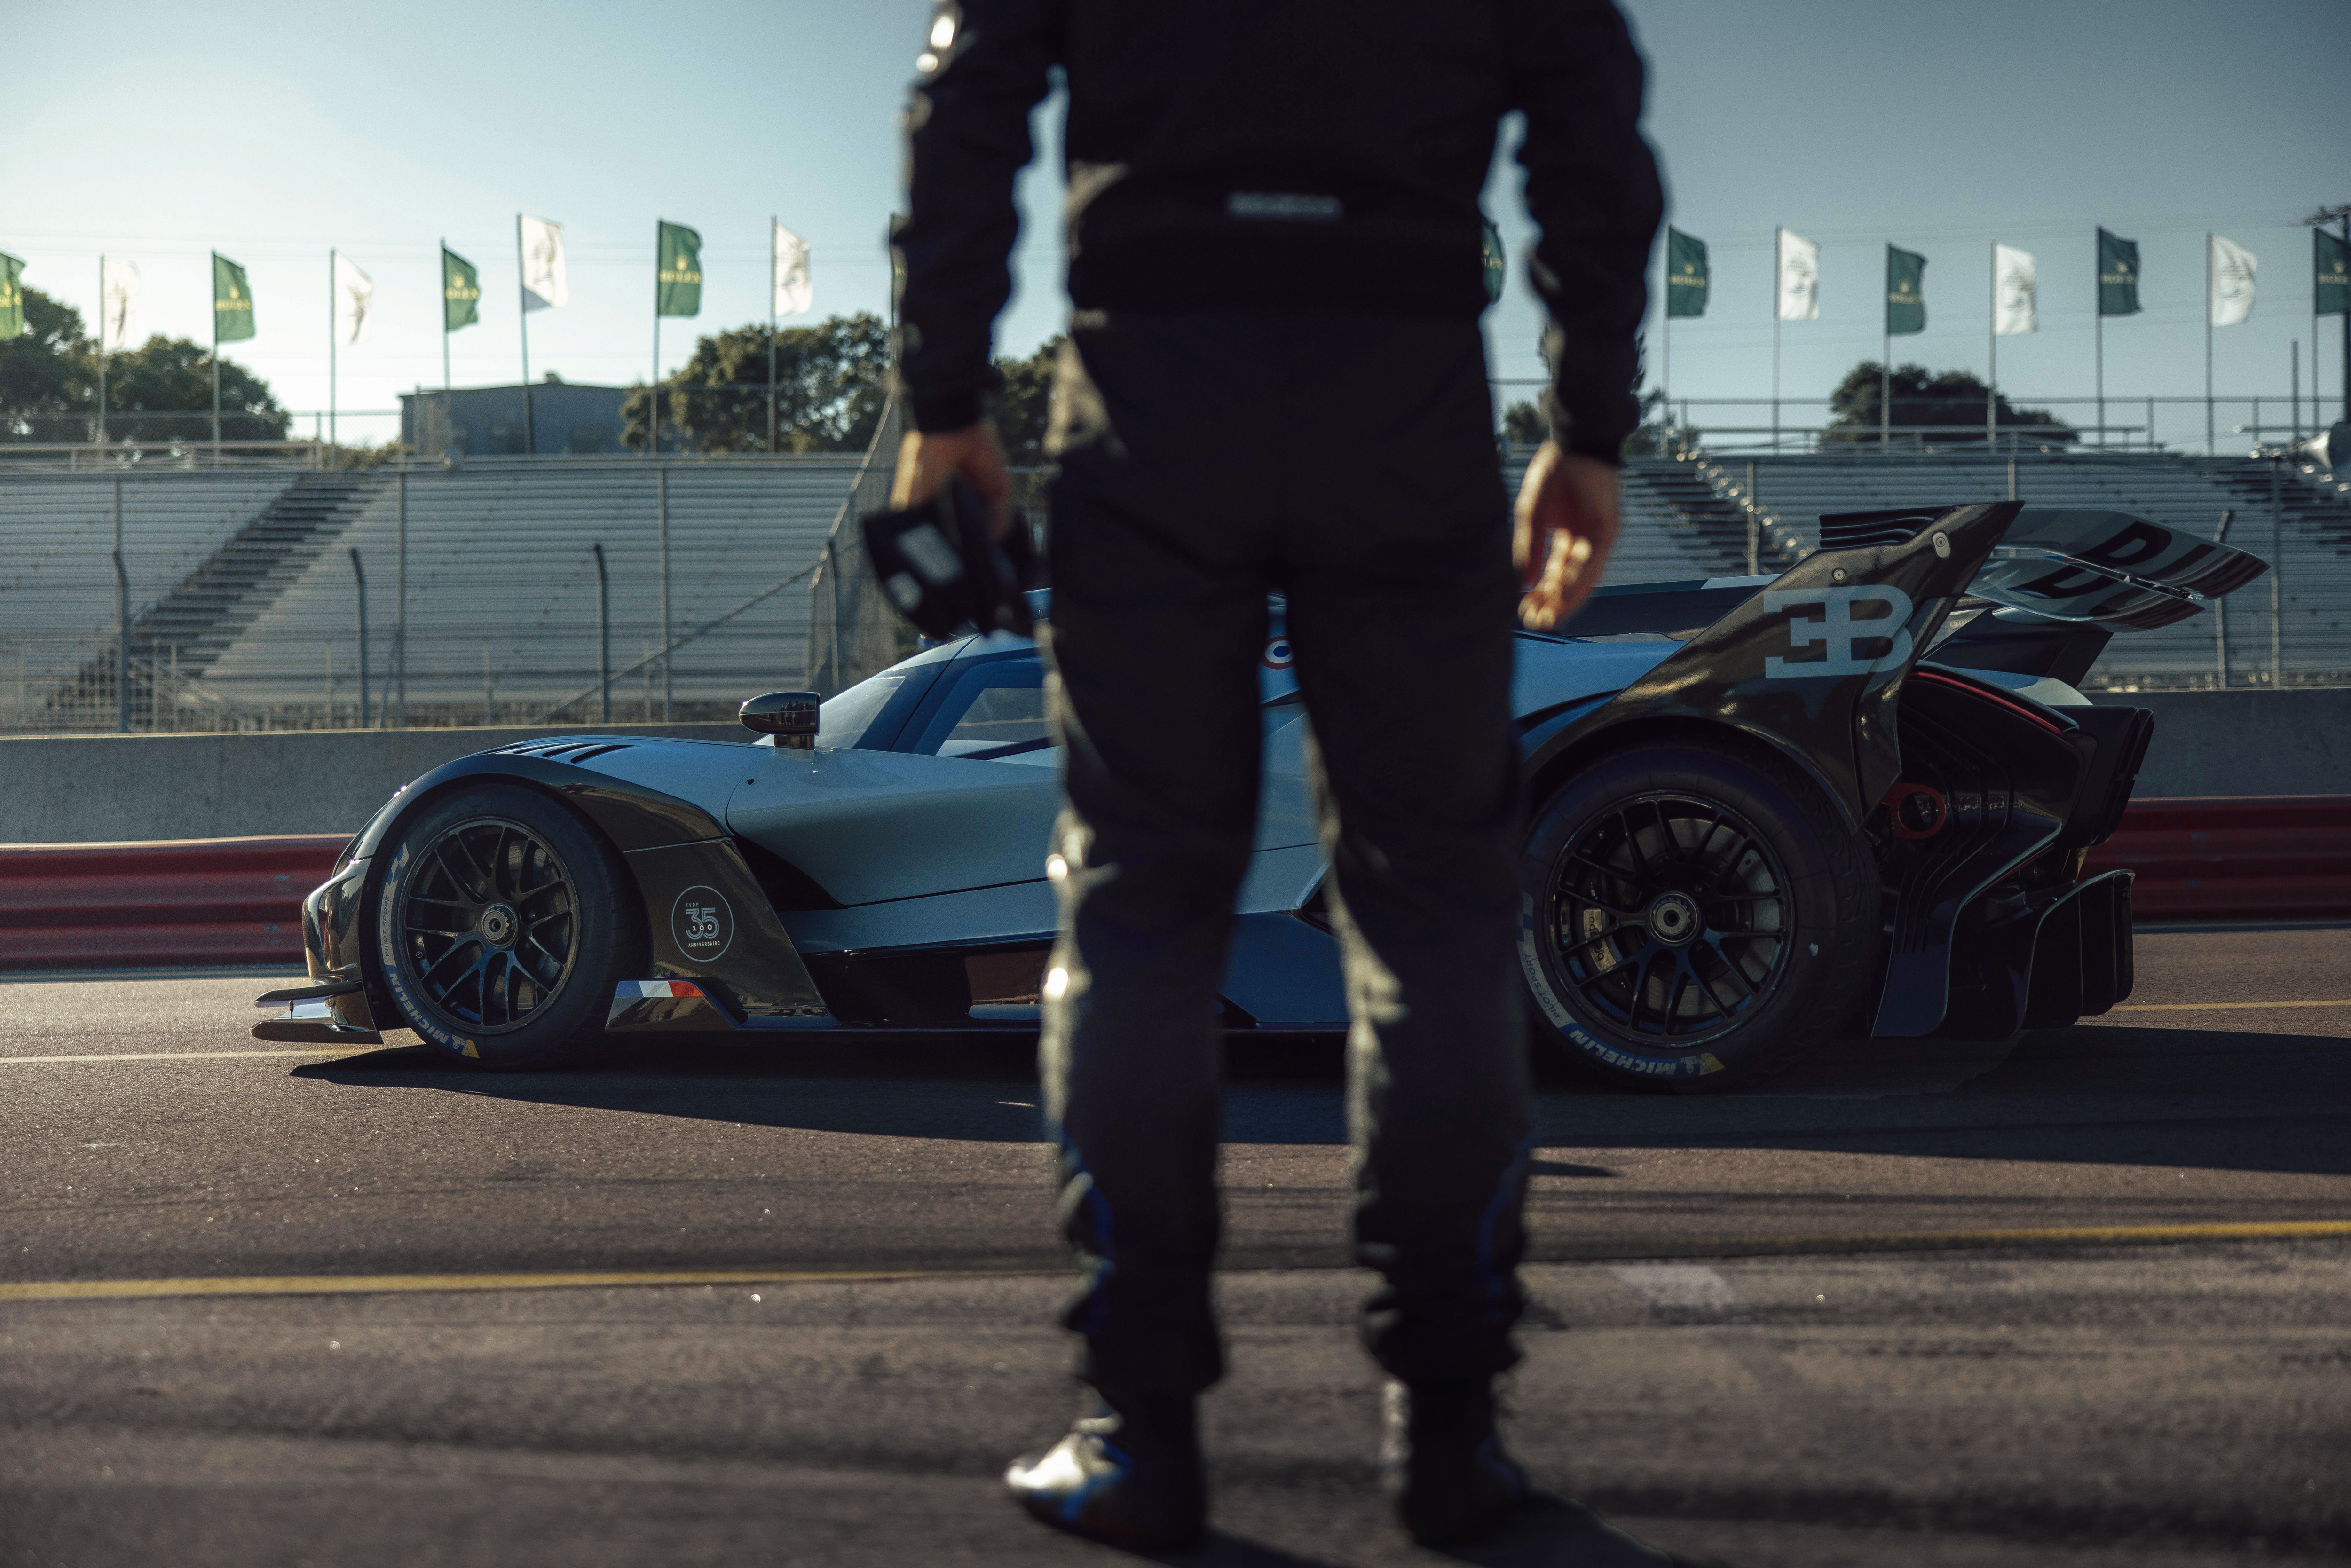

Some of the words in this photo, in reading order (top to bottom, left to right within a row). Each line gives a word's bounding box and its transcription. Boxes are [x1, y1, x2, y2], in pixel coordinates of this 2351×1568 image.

[659, 270, 701, 284] ROLEX
[2100, 273, 2136, 284] ROLX
[215, 299, 252, 311] ROLEX
[445, 287, 480, 300] OLEX
[686, 907, 720, 940] 35
[1588, 917, 1604, 961] brbo
[1522, 953, 1542, 988] SPORT
[389, 973, 450, 1044] MICHELIN
[1538, 990, 1561, 1018] PILOT
[1570, 1028, 1677, 1075] MICHELIN
